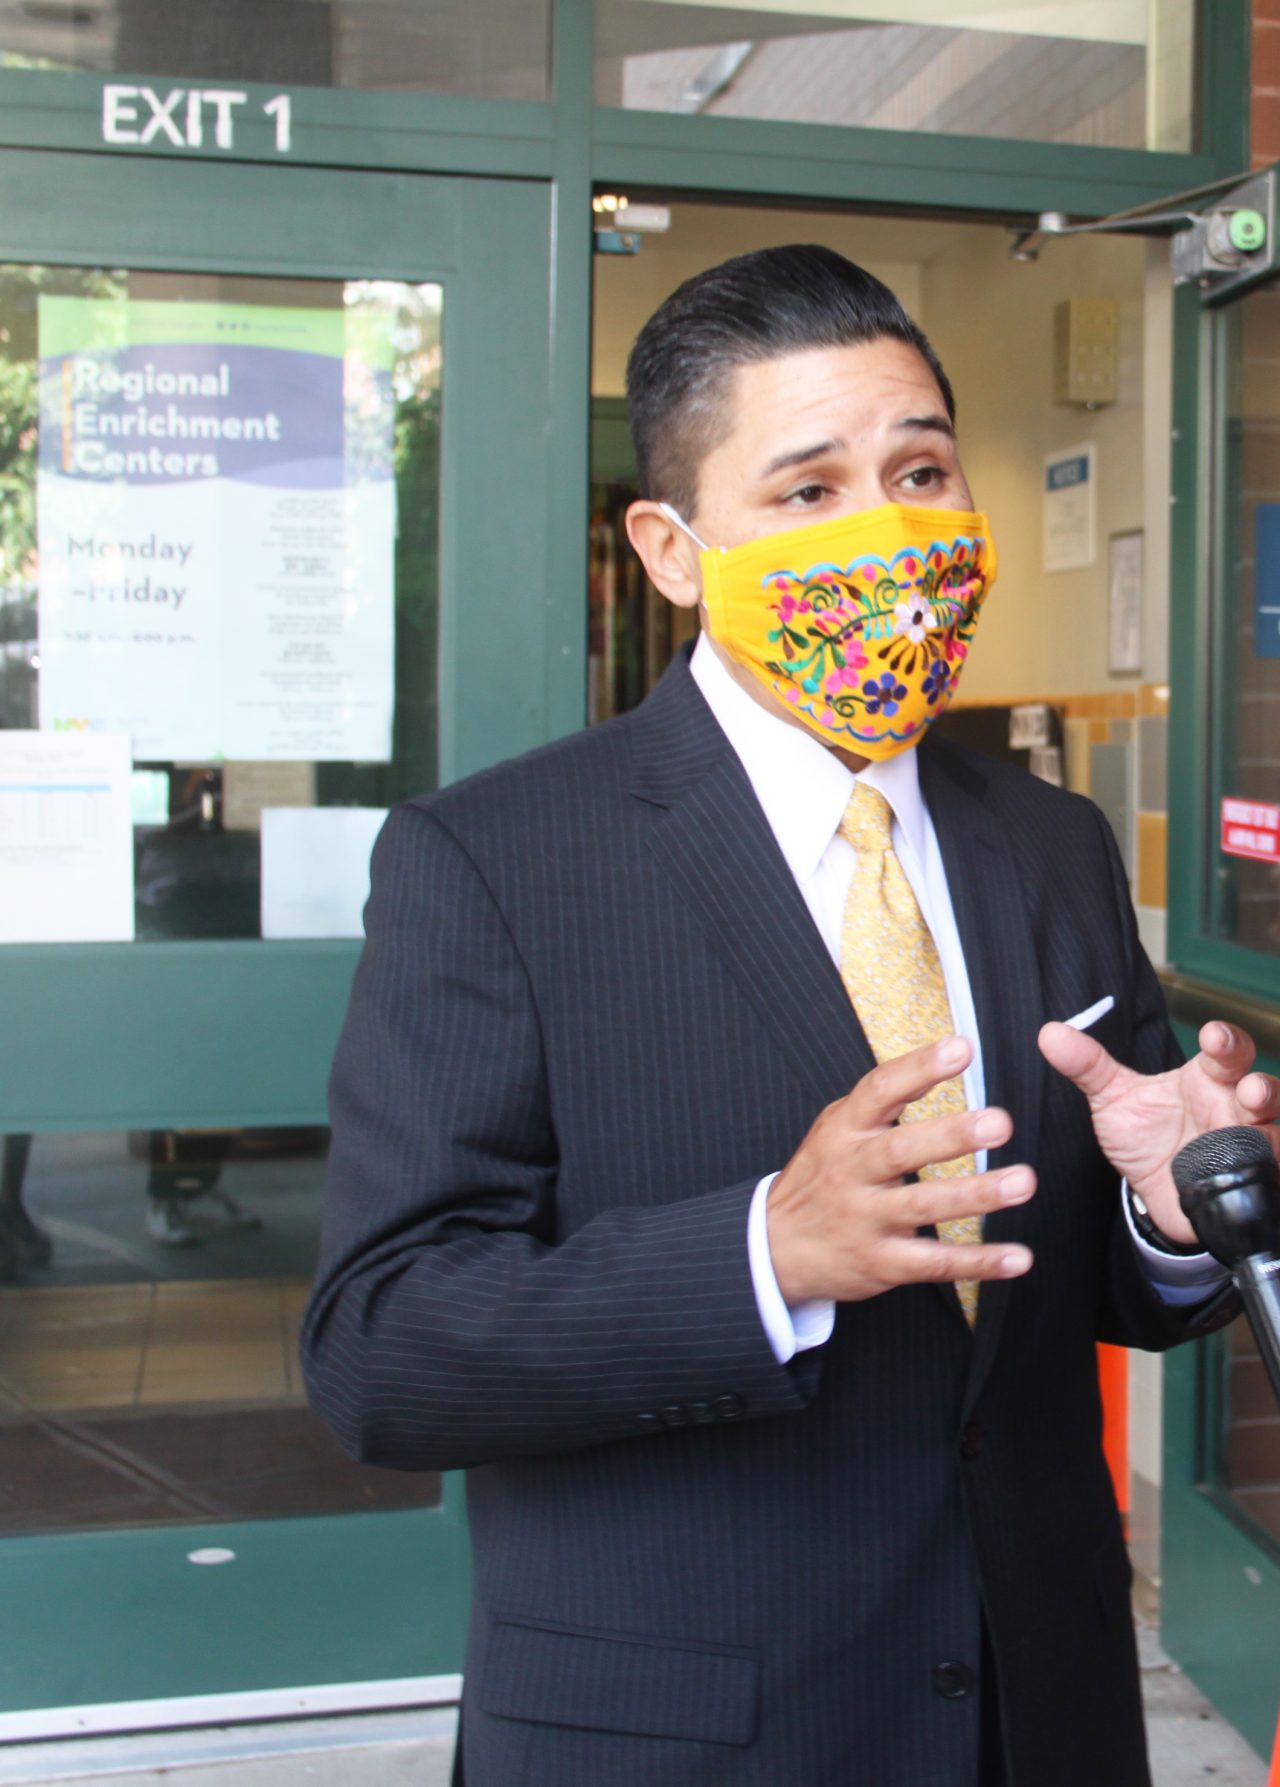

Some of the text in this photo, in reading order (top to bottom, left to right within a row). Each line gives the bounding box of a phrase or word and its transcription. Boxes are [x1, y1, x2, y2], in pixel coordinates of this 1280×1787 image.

[102, 84, 290, 152] EXIT 1
[74, 359, 229, 401] Regional
[74, 402, 281, 441] Enrichment
[74, 440, 219, 476] Centers
[66, 532, 194, 568] Monday
